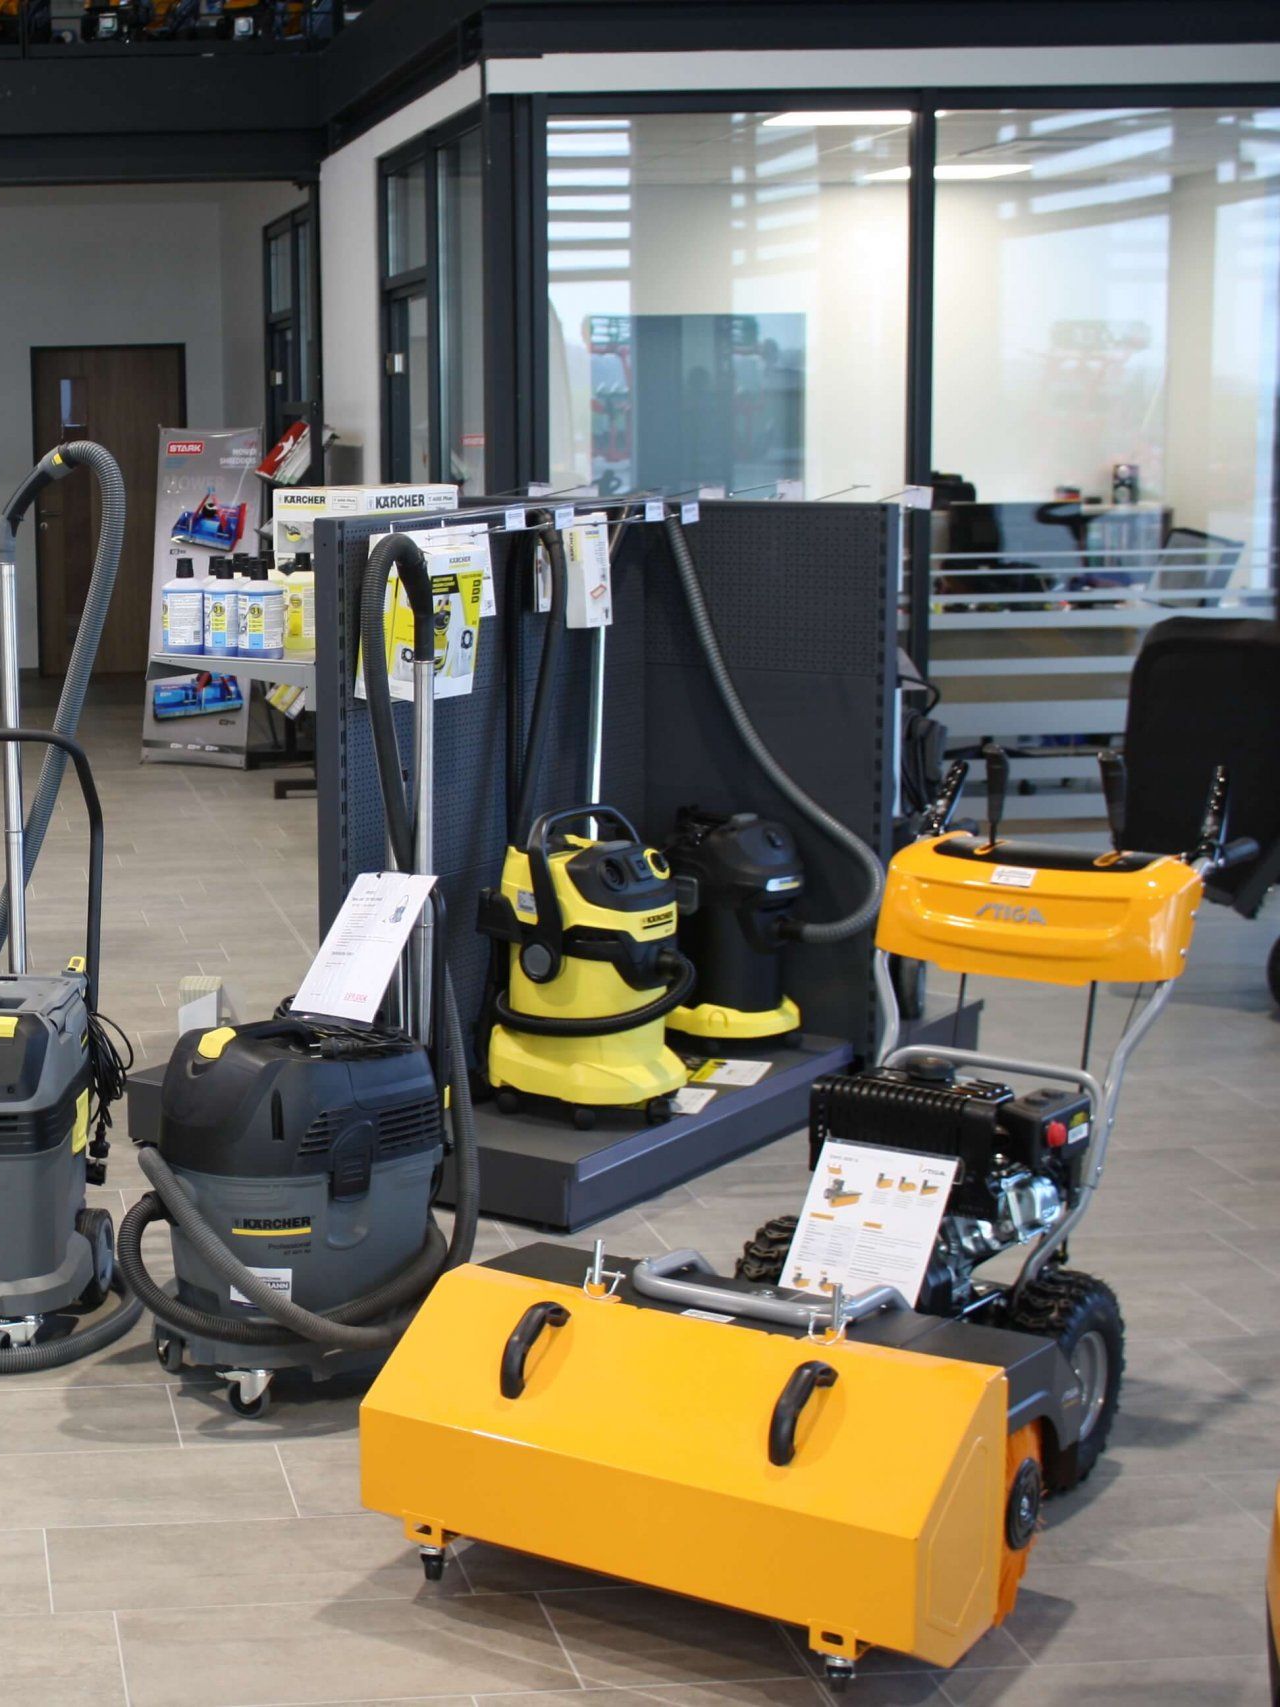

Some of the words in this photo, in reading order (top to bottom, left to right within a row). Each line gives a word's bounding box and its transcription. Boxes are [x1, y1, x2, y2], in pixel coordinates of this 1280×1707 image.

[169, 444, 202, 453] STARK
[283, 495, 326, 505] KÄRCHER
[375, 493, 425, 509] KÄRCHER
[975, 902, 1047, 926] STIGA
[243, 1216, 311, 1229] KÄRCHER
